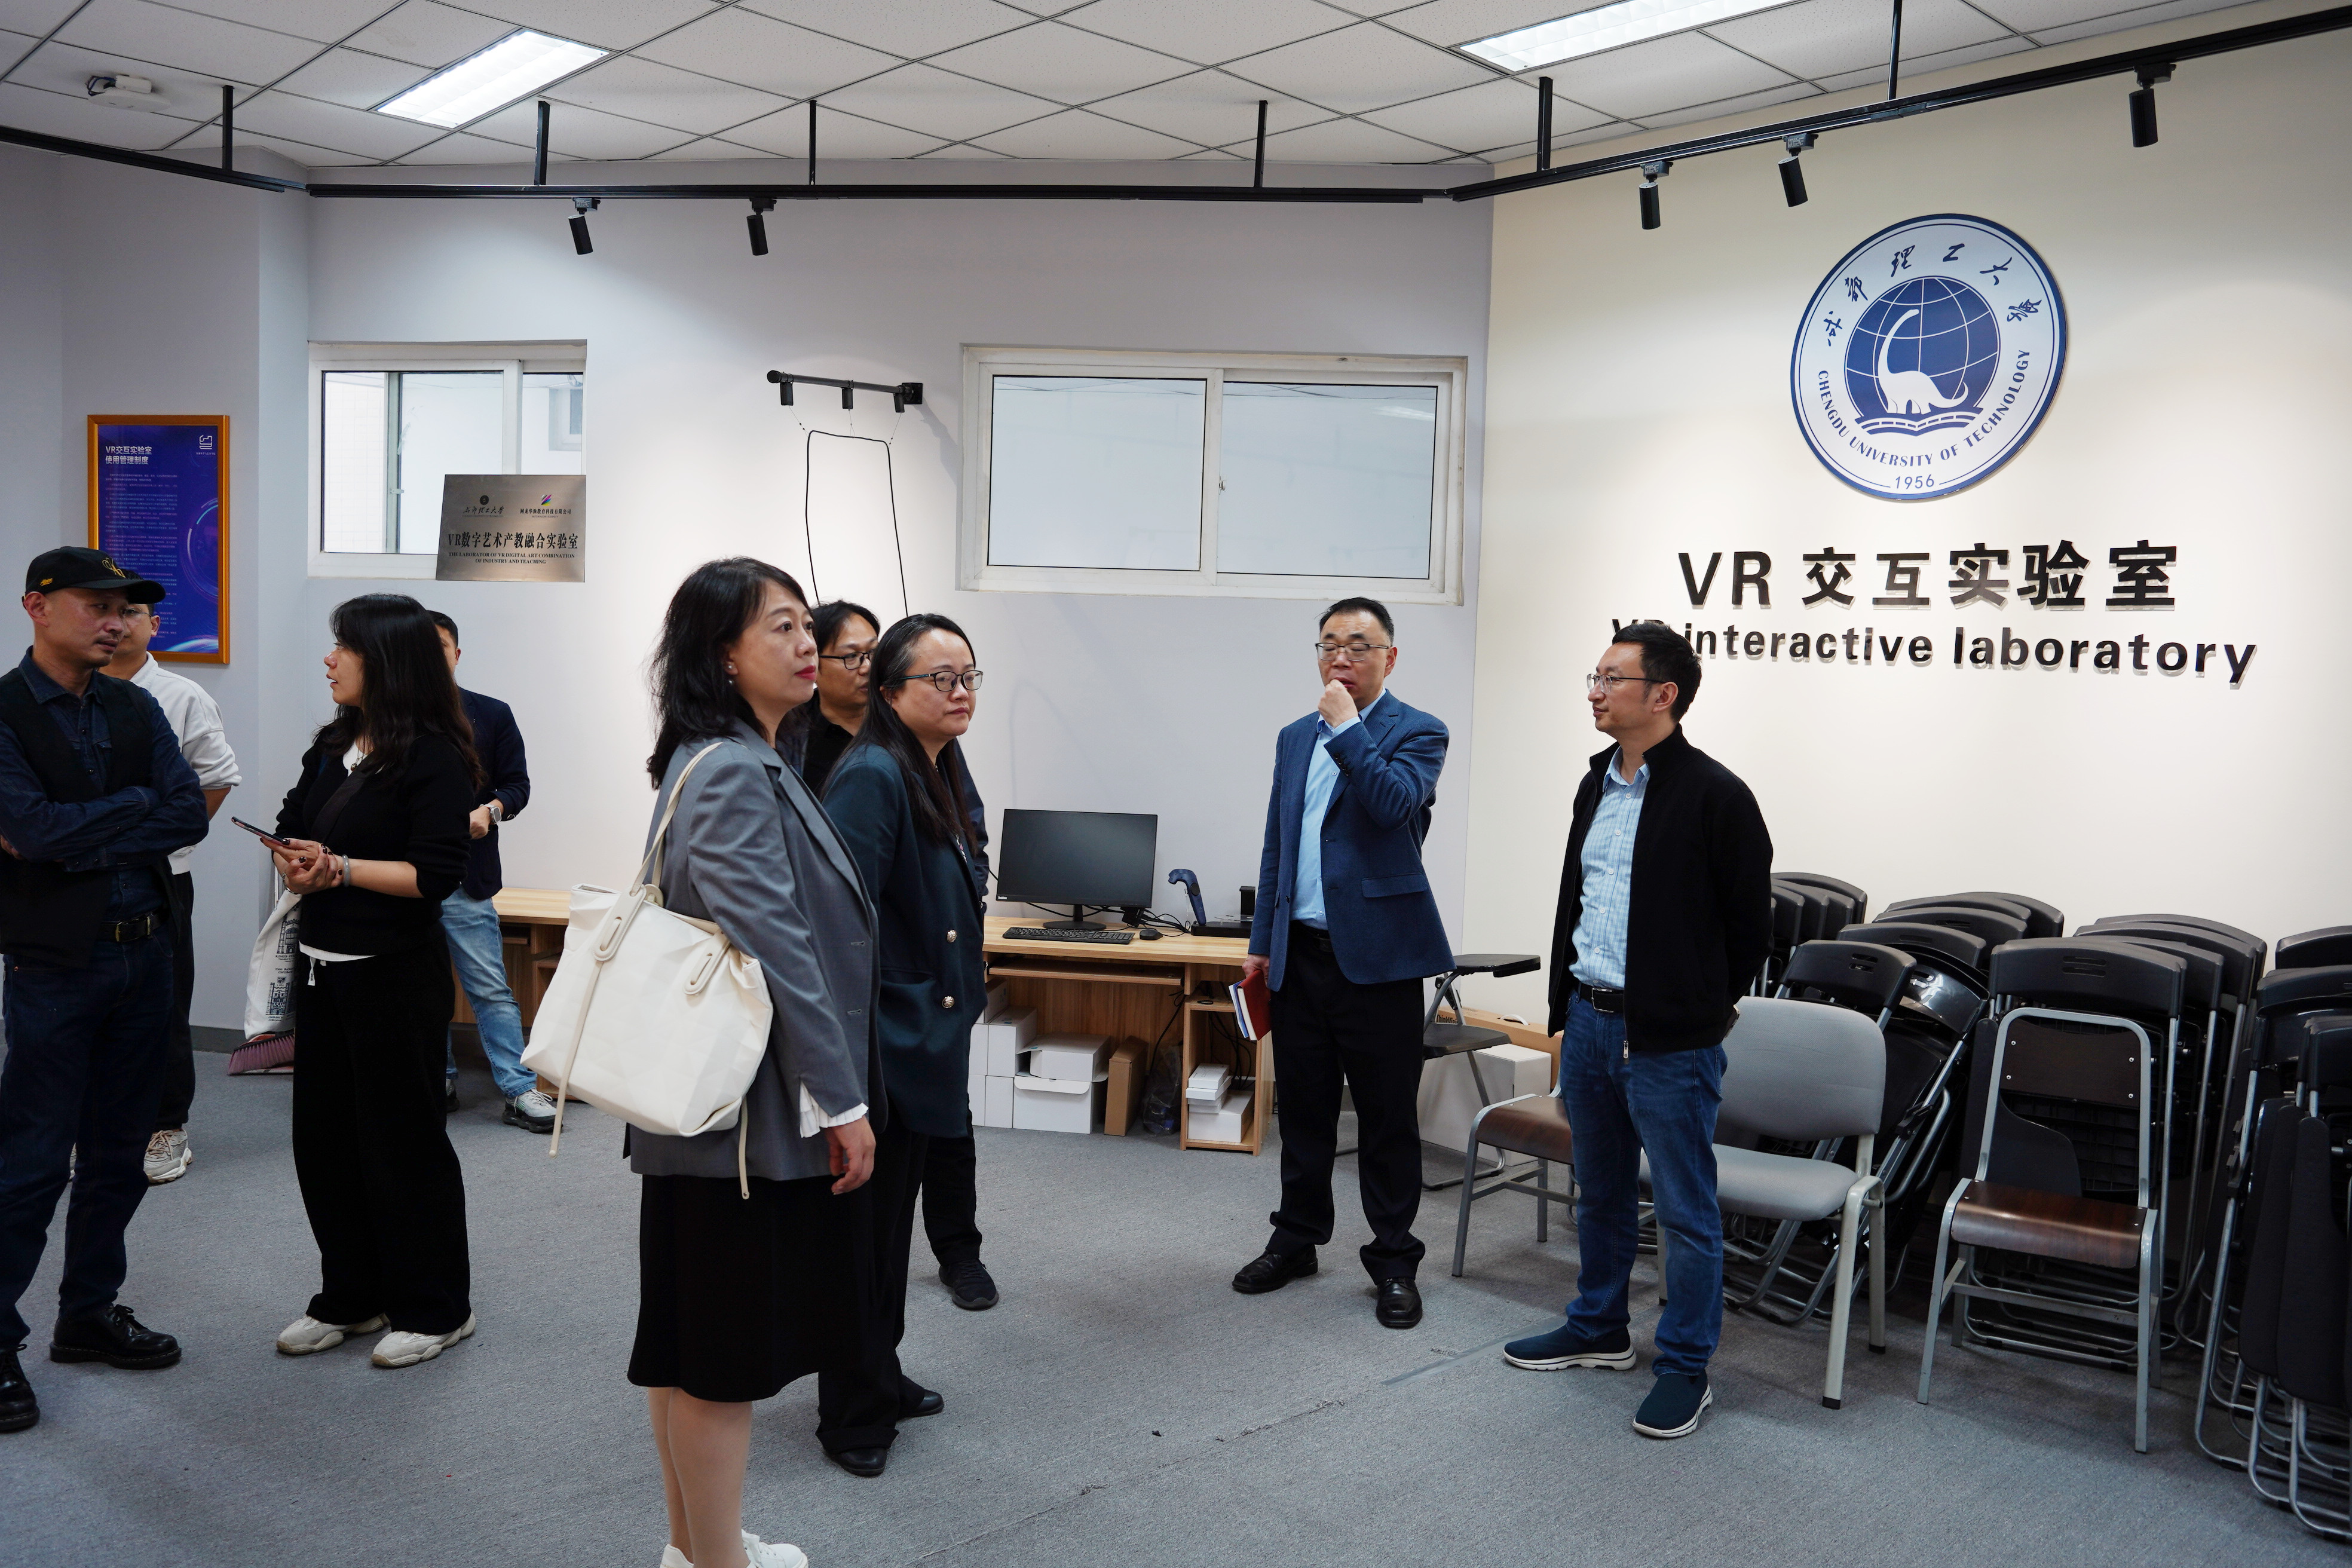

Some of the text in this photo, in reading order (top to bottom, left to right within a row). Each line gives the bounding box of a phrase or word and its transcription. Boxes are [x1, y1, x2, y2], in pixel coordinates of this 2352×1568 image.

[1818, 350, 2031, 467] CHENGDU UNIVERSITY OF TECHNOLOGY
[105, 455, 149, 465] 使用管理制度
[1895, 474, 1935, 490] 1956
[448, 531, 578, 549] VR数字艺术产教融合实验室
[1679, 540, 2177, 607] VR 交互实验室
[1685, 623, 2257, 684] interactive laboratory
